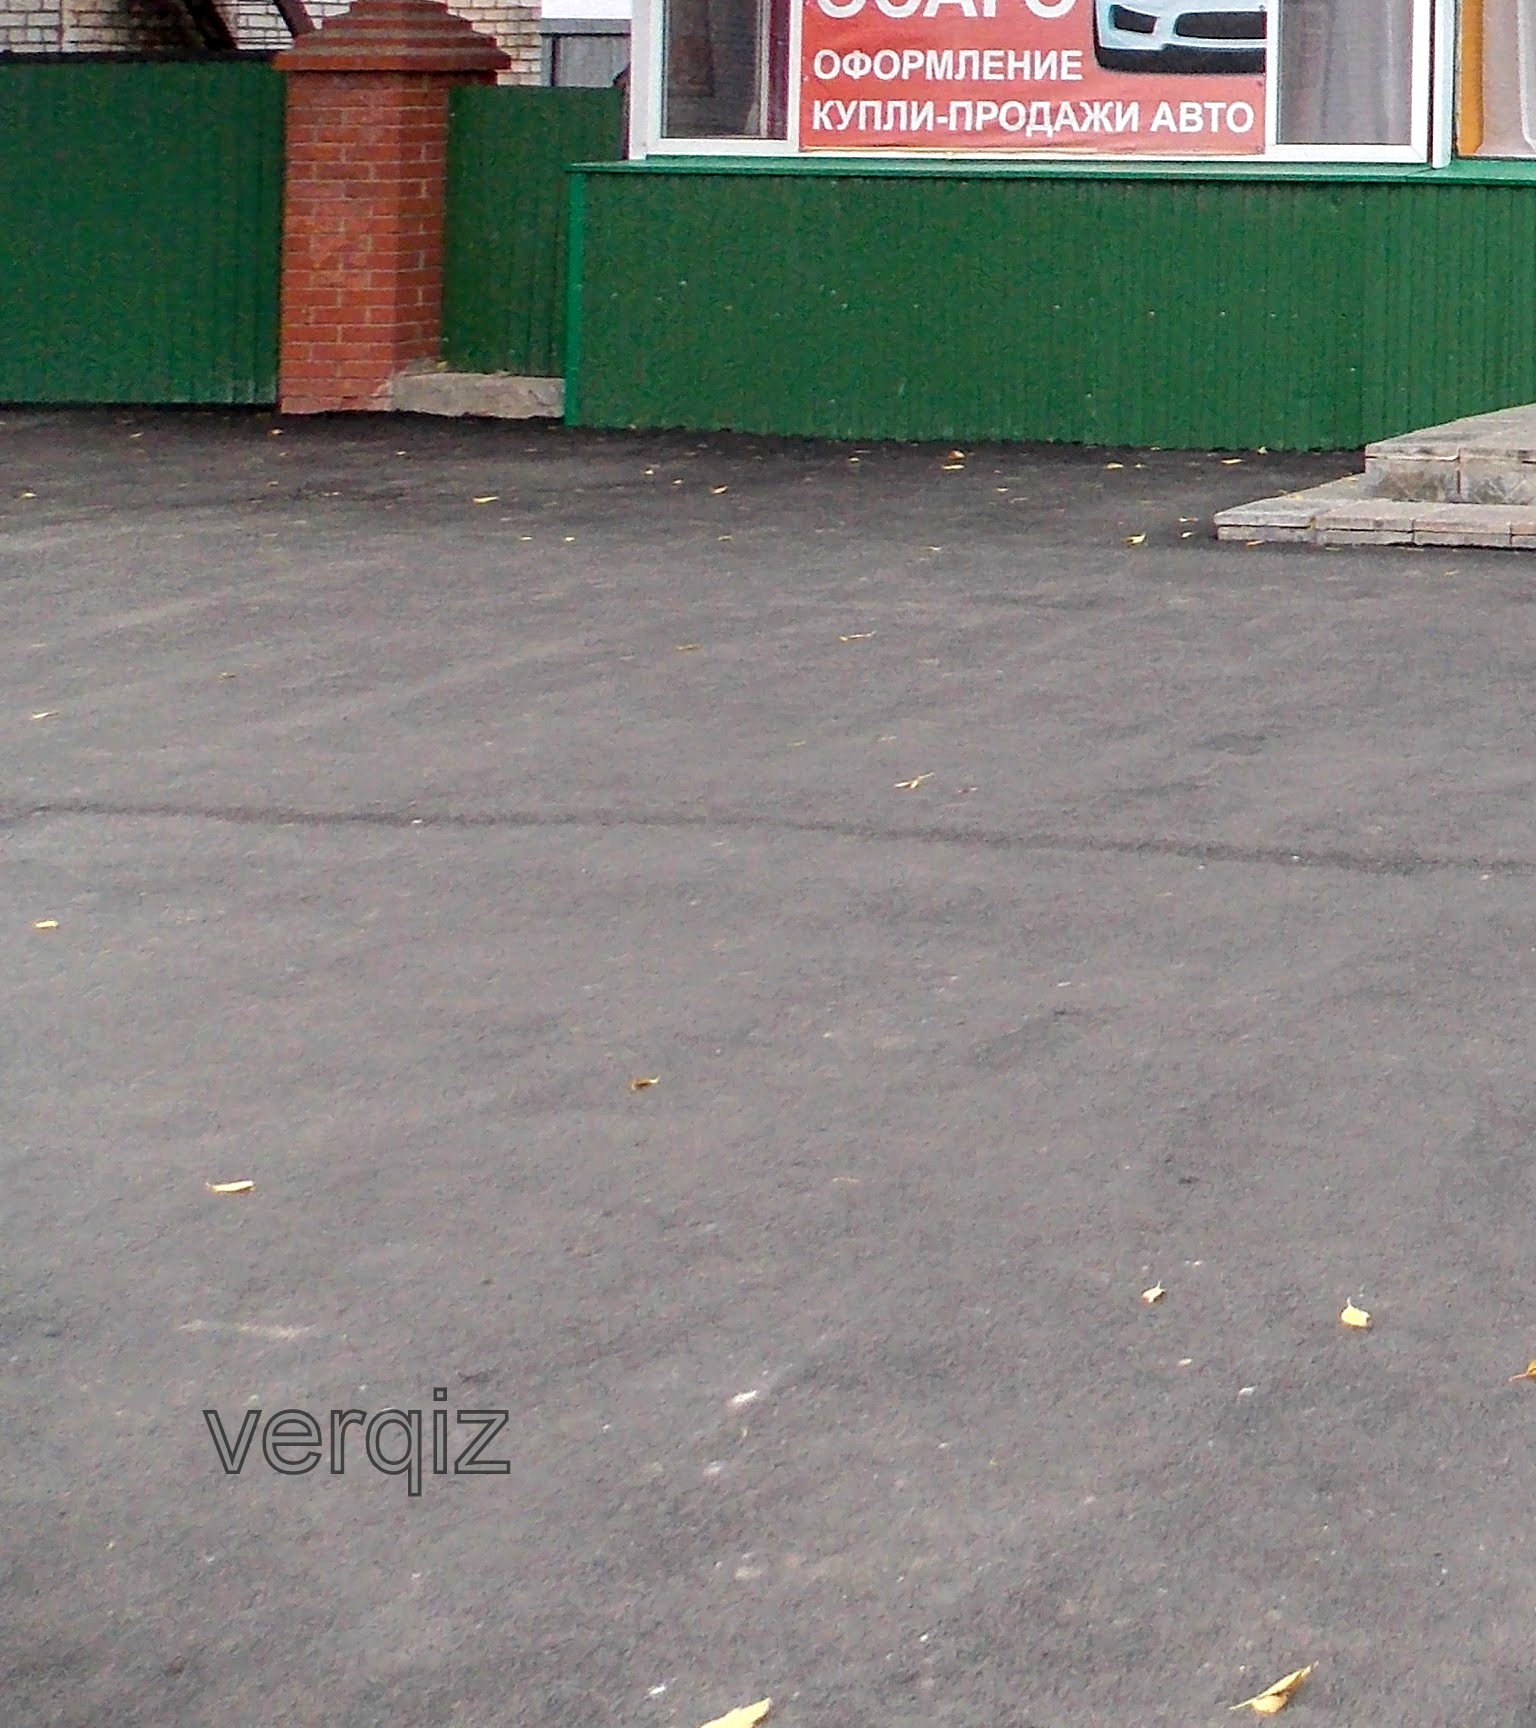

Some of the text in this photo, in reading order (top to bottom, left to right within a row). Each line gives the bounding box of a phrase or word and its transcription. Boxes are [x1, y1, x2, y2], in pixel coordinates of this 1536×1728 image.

[813, 49, 1084, 81] ОФОРМЛЕНИЕ
[812, 99, 1255, 138] КУПЛИ-ПРОДАЖИ АВТО
